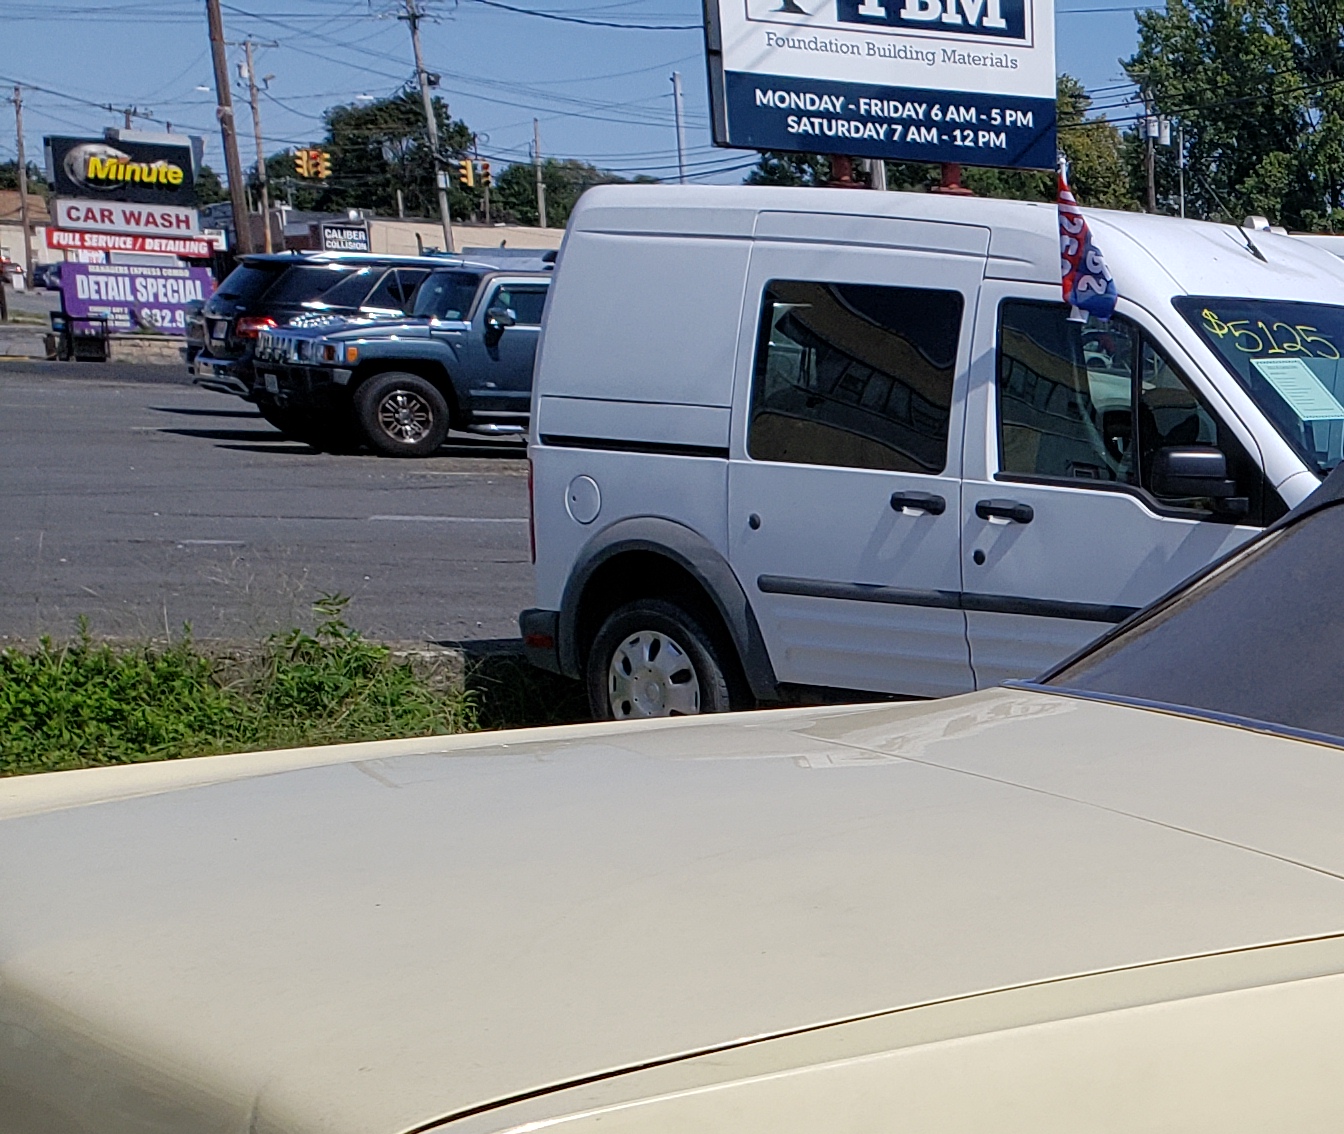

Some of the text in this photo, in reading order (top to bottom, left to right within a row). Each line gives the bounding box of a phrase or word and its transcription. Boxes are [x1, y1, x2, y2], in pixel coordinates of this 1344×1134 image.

[765, 31, 1018, 69] Foundation Building Materials
[755, 88, 844, 113] MONDAY
[859, 97, 927, 120] FRIDAY
[930, 104, 943, 121] 6
[945, 105, 976, 124] AM
[990, 108, 1001, 125] 5
[1005, 109, 1033, 128] PM
[786, 115, 888, 141] SATURDAY
[891, 124, 903, 141] 7
[906, 125, 938, 144] AM
[952, 128, 975, 146] 12
[978, 130, 1006, 149] PM
[87, 156, 184, 185] Minute
[66, 205, 191, 230] CAR WASH
[53, 231, 208, 257] FULL SERVICE / DETAILING
[324, 228, 366, 240] CALIBER
[325, 239, 367, 251] COLLISION
[75, 274, 204, 303] DETAIL SPECIAL
[141, 307, 185, 328] $32.9
